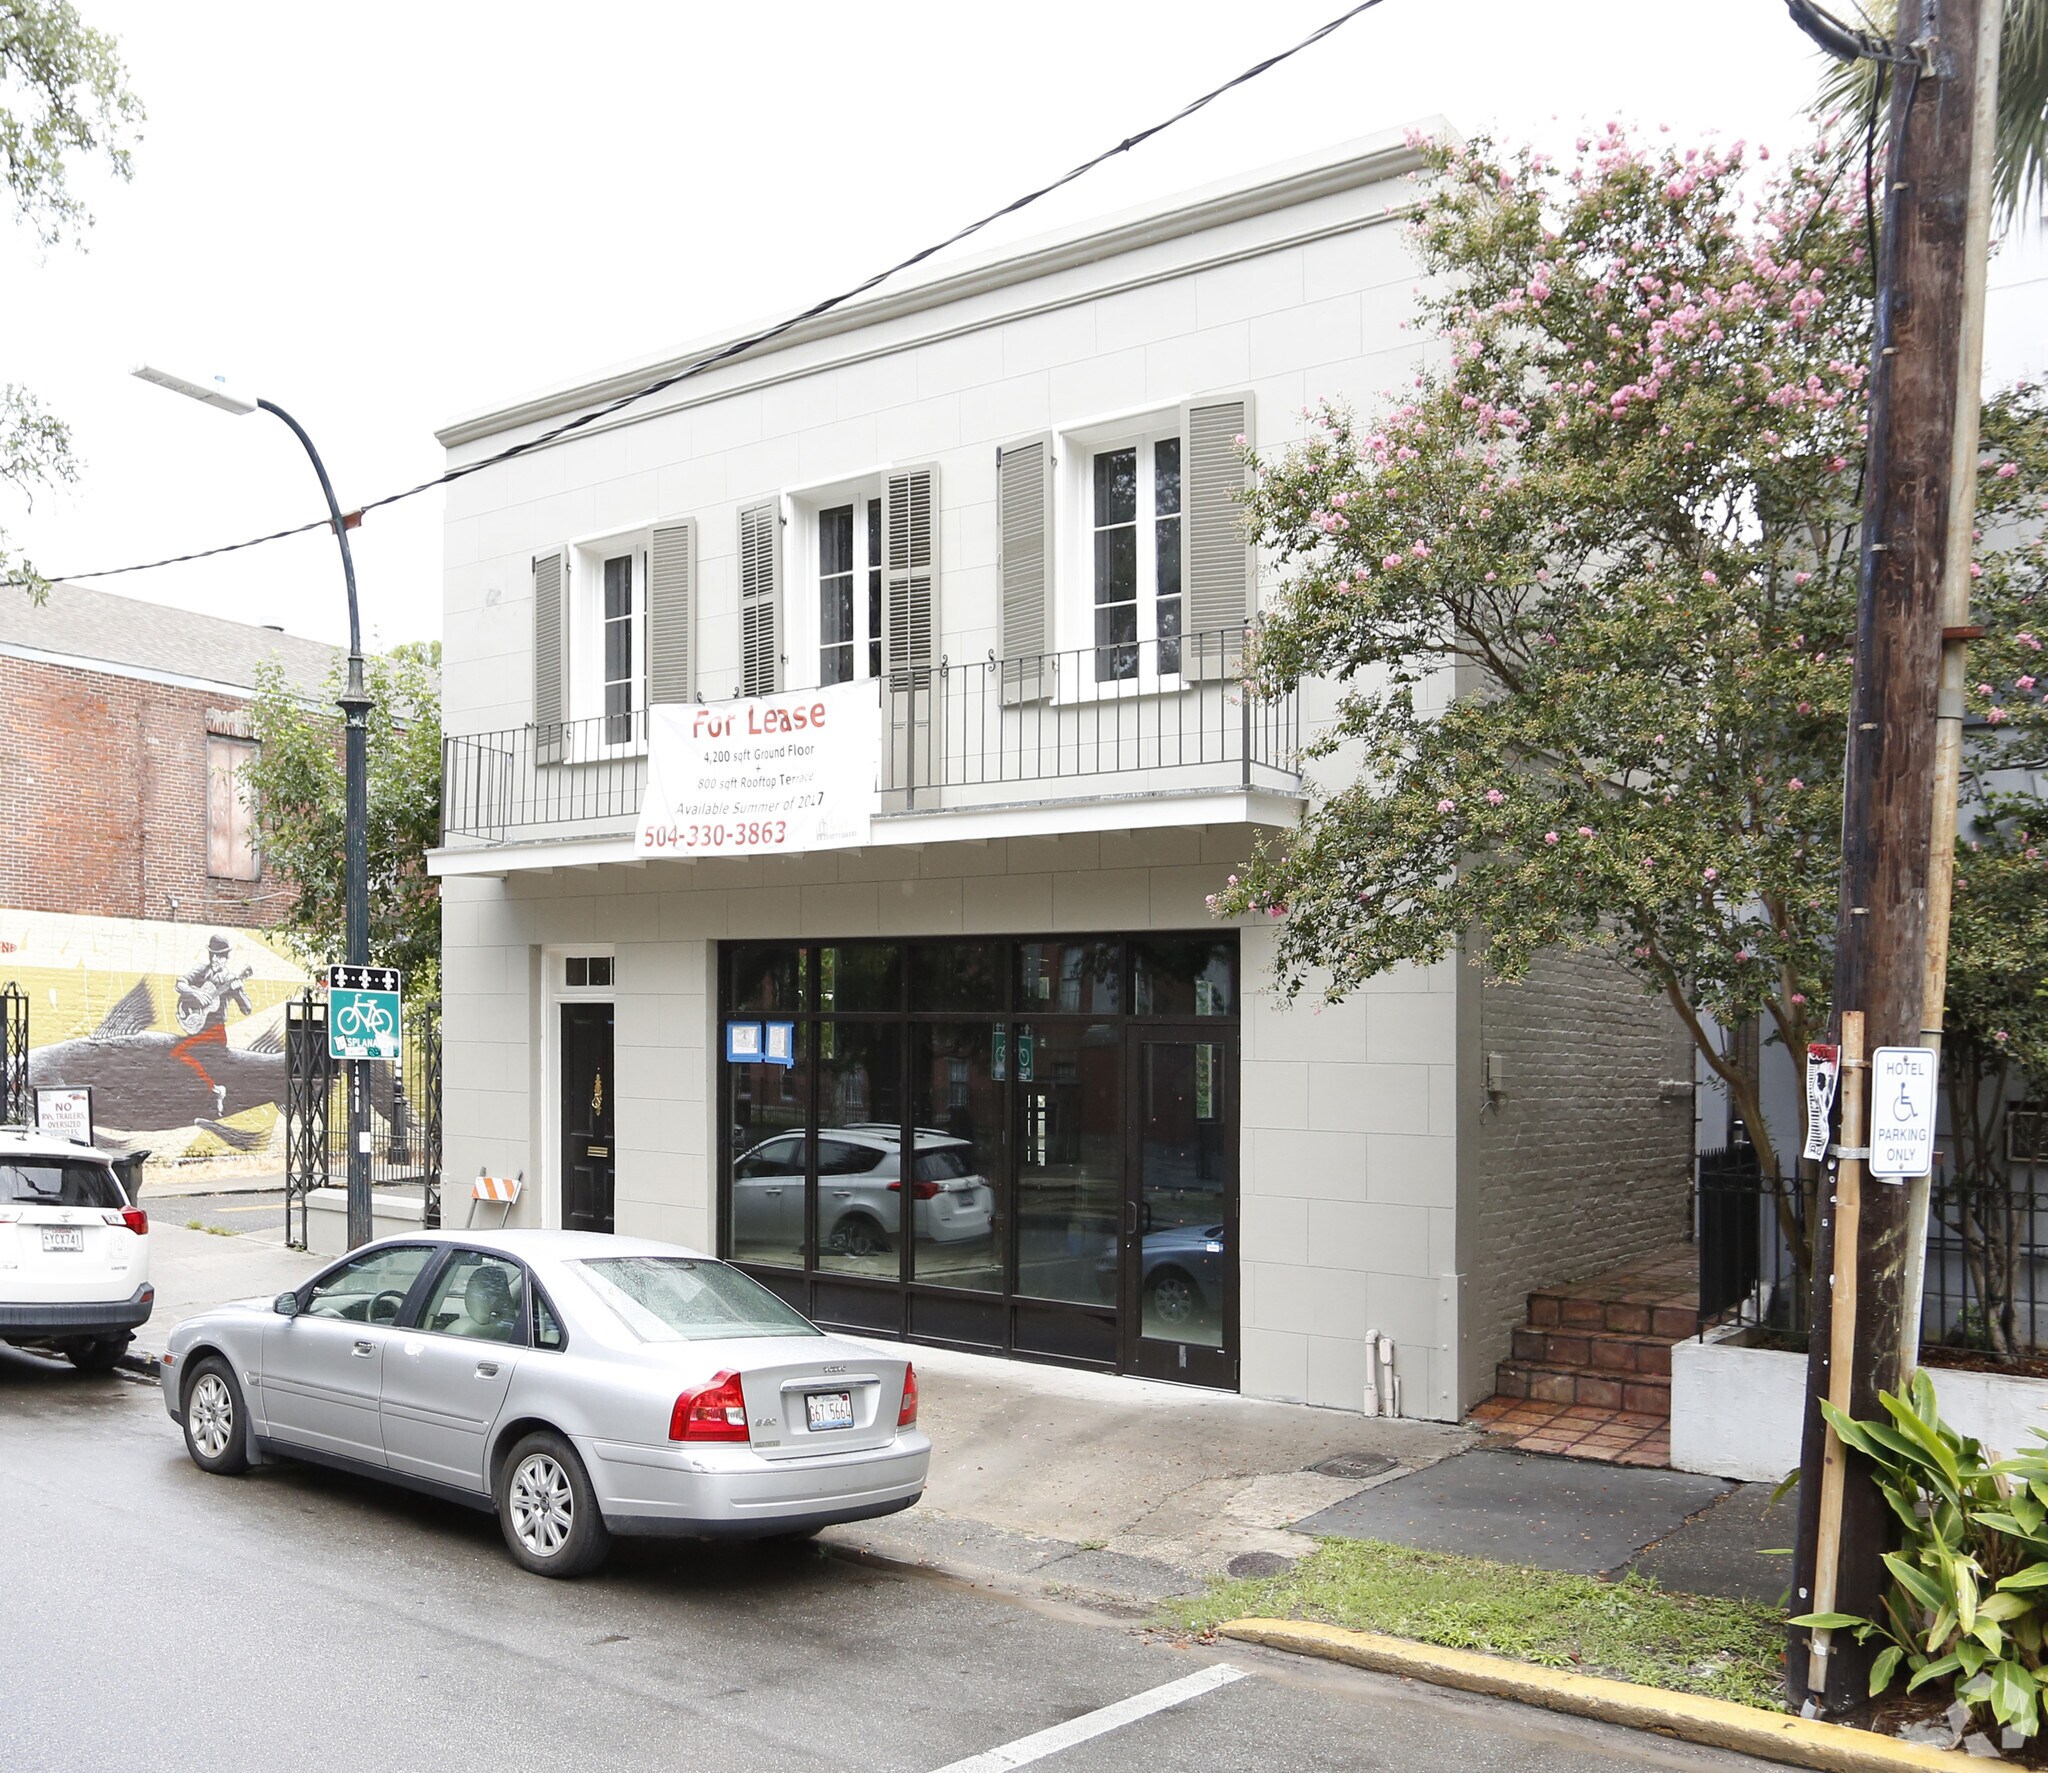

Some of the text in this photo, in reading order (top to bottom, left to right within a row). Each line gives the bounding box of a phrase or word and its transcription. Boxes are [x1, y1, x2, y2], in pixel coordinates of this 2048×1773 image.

[693, 702, 826, 738] For Lease
[704, 744, 815, 763] 4,200 sqft Ground Floor
[698, 772, 814, 791] 800 sqft Rooftop Terrace
[675, 802, 729, 816] Available
[732, 799, 780, 814] Summer
[783, 796, 793, 811] of
[644, 820, 787, 848] 504-330-3863
[1886, 1062, 1924, 1076] HOTEL
[55, 1102, 72, 1111] NO
[47, 1120, 81, 1128] OVERSIZED
[1878, 1128, 1927, 1141] PARKING
[1887, 1148, 1916, 1161] ONLY
